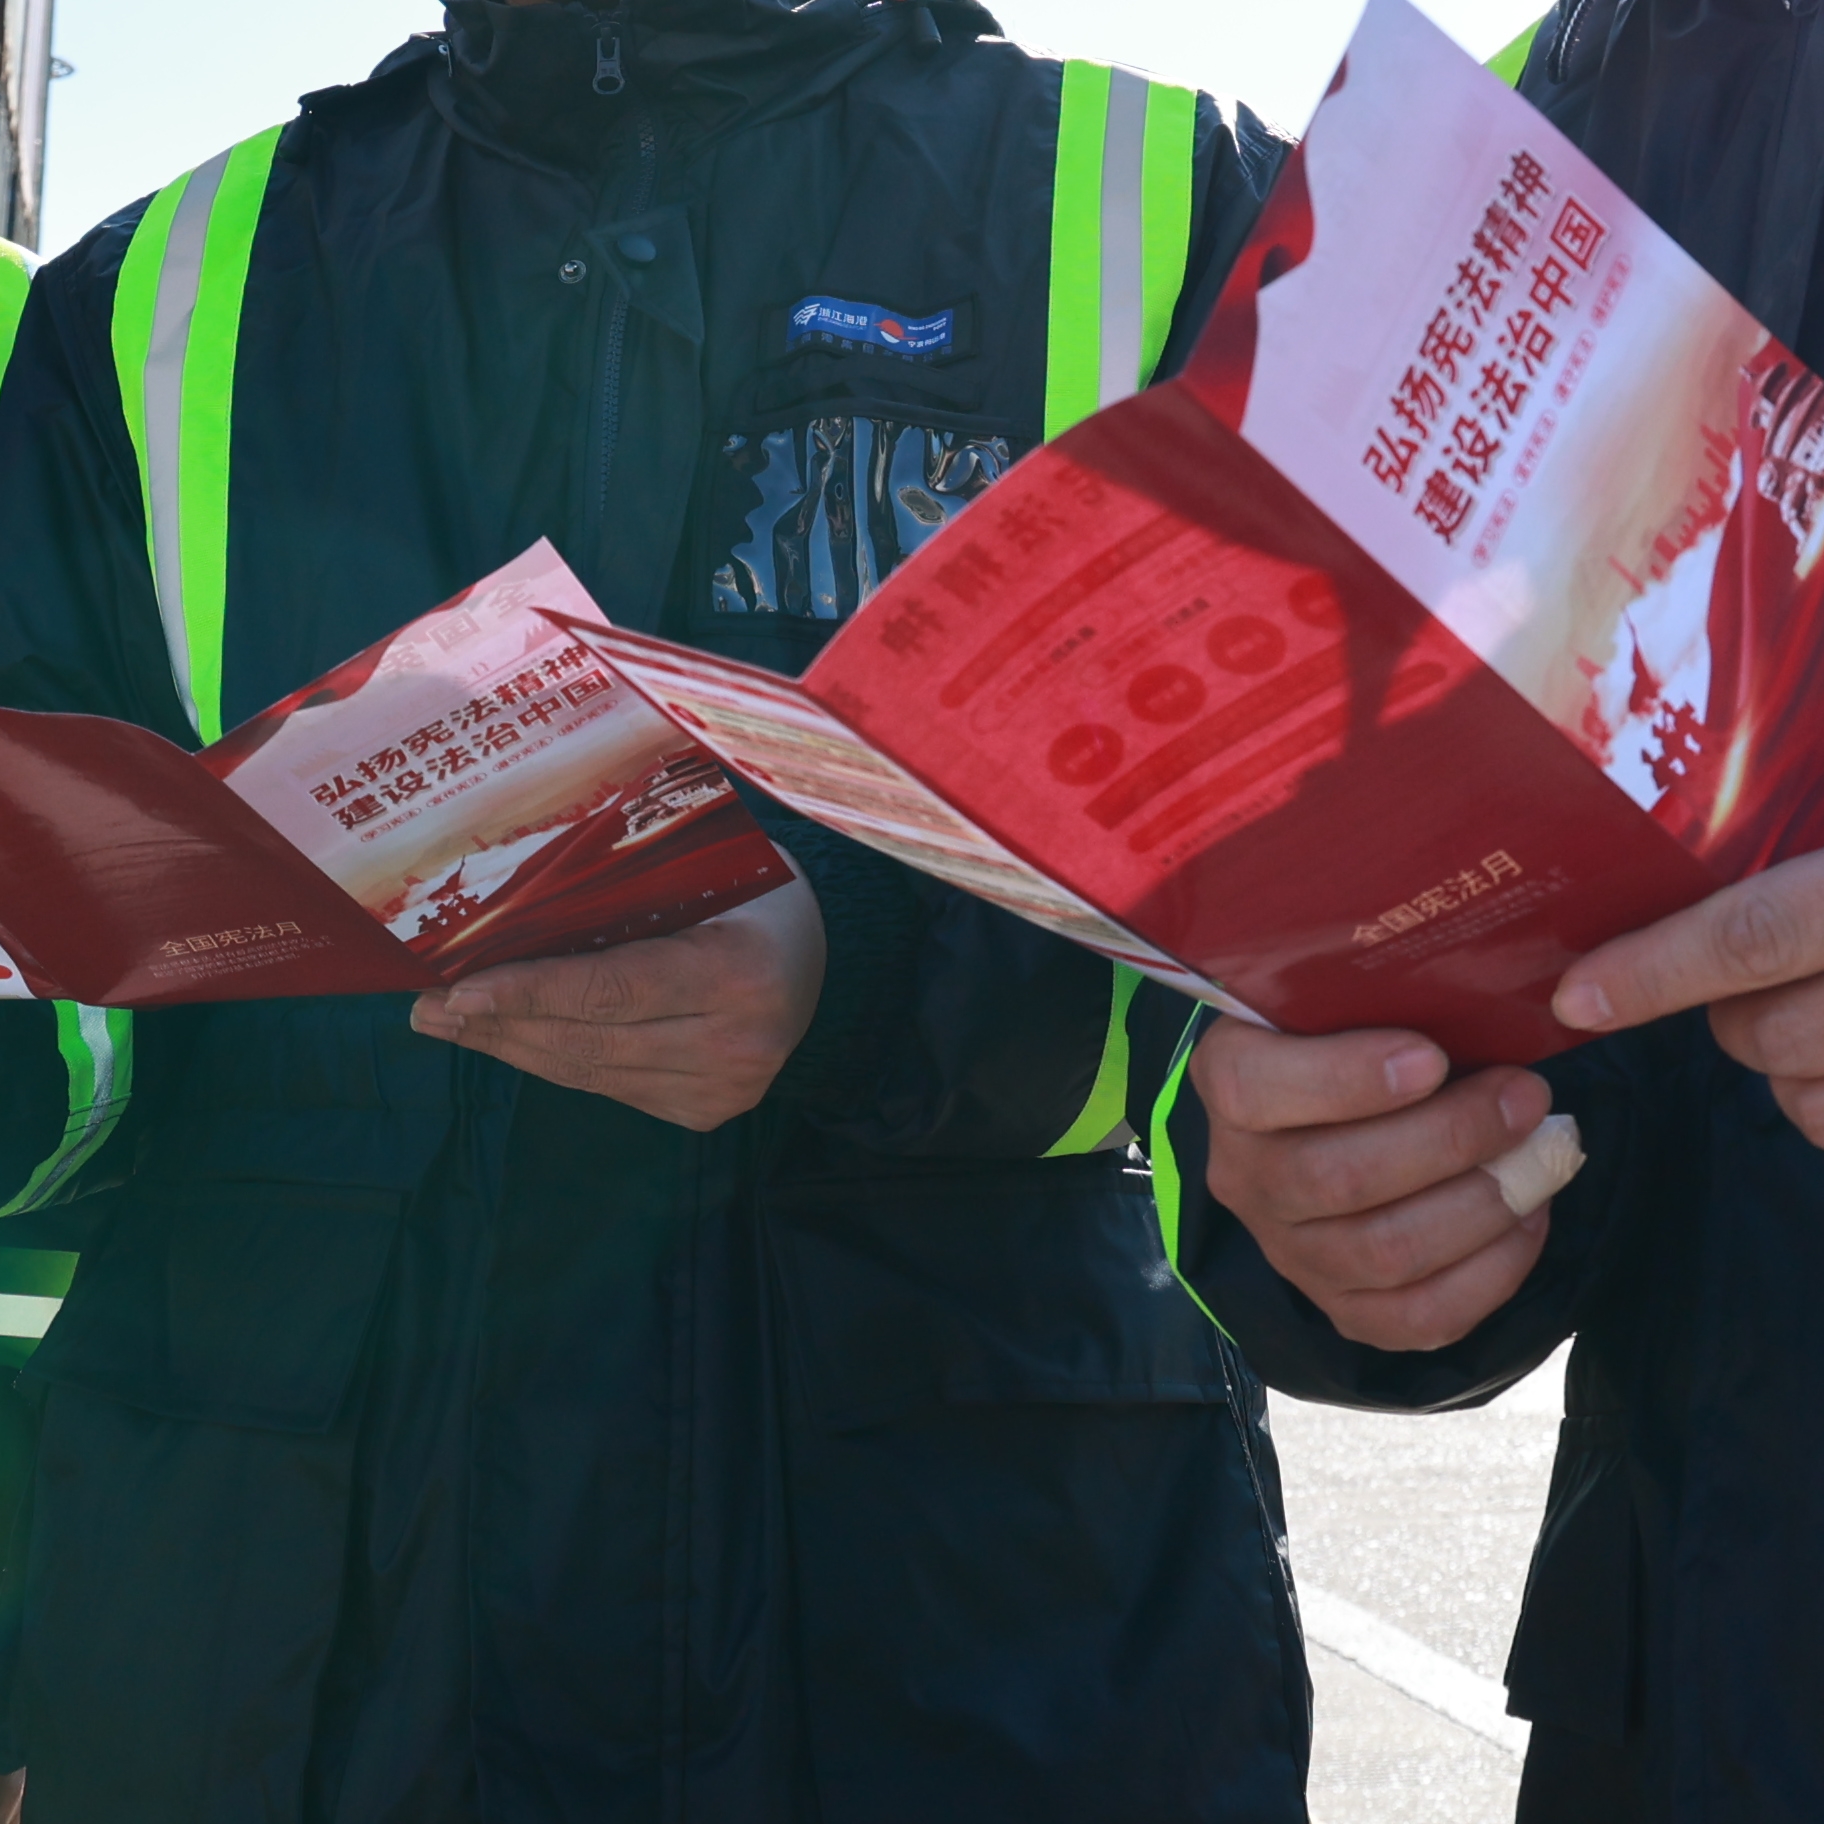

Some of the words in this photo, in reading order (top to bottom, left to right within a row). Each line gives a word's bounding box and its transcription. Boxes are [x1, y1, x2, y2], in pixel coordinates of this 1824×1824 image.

[1362, 149, 1551, 496] 弘扬宪法精神
[1413, 194, 1609, 548] 建设法治中国
[308, 644, 594, 809] 弘扬宪法精神
[331, 668, 616, 832] 建设法治中国
[160, 921, 303, 959] 全国宪法月
[1350, 849, 1524, 950] 全国宪法月
